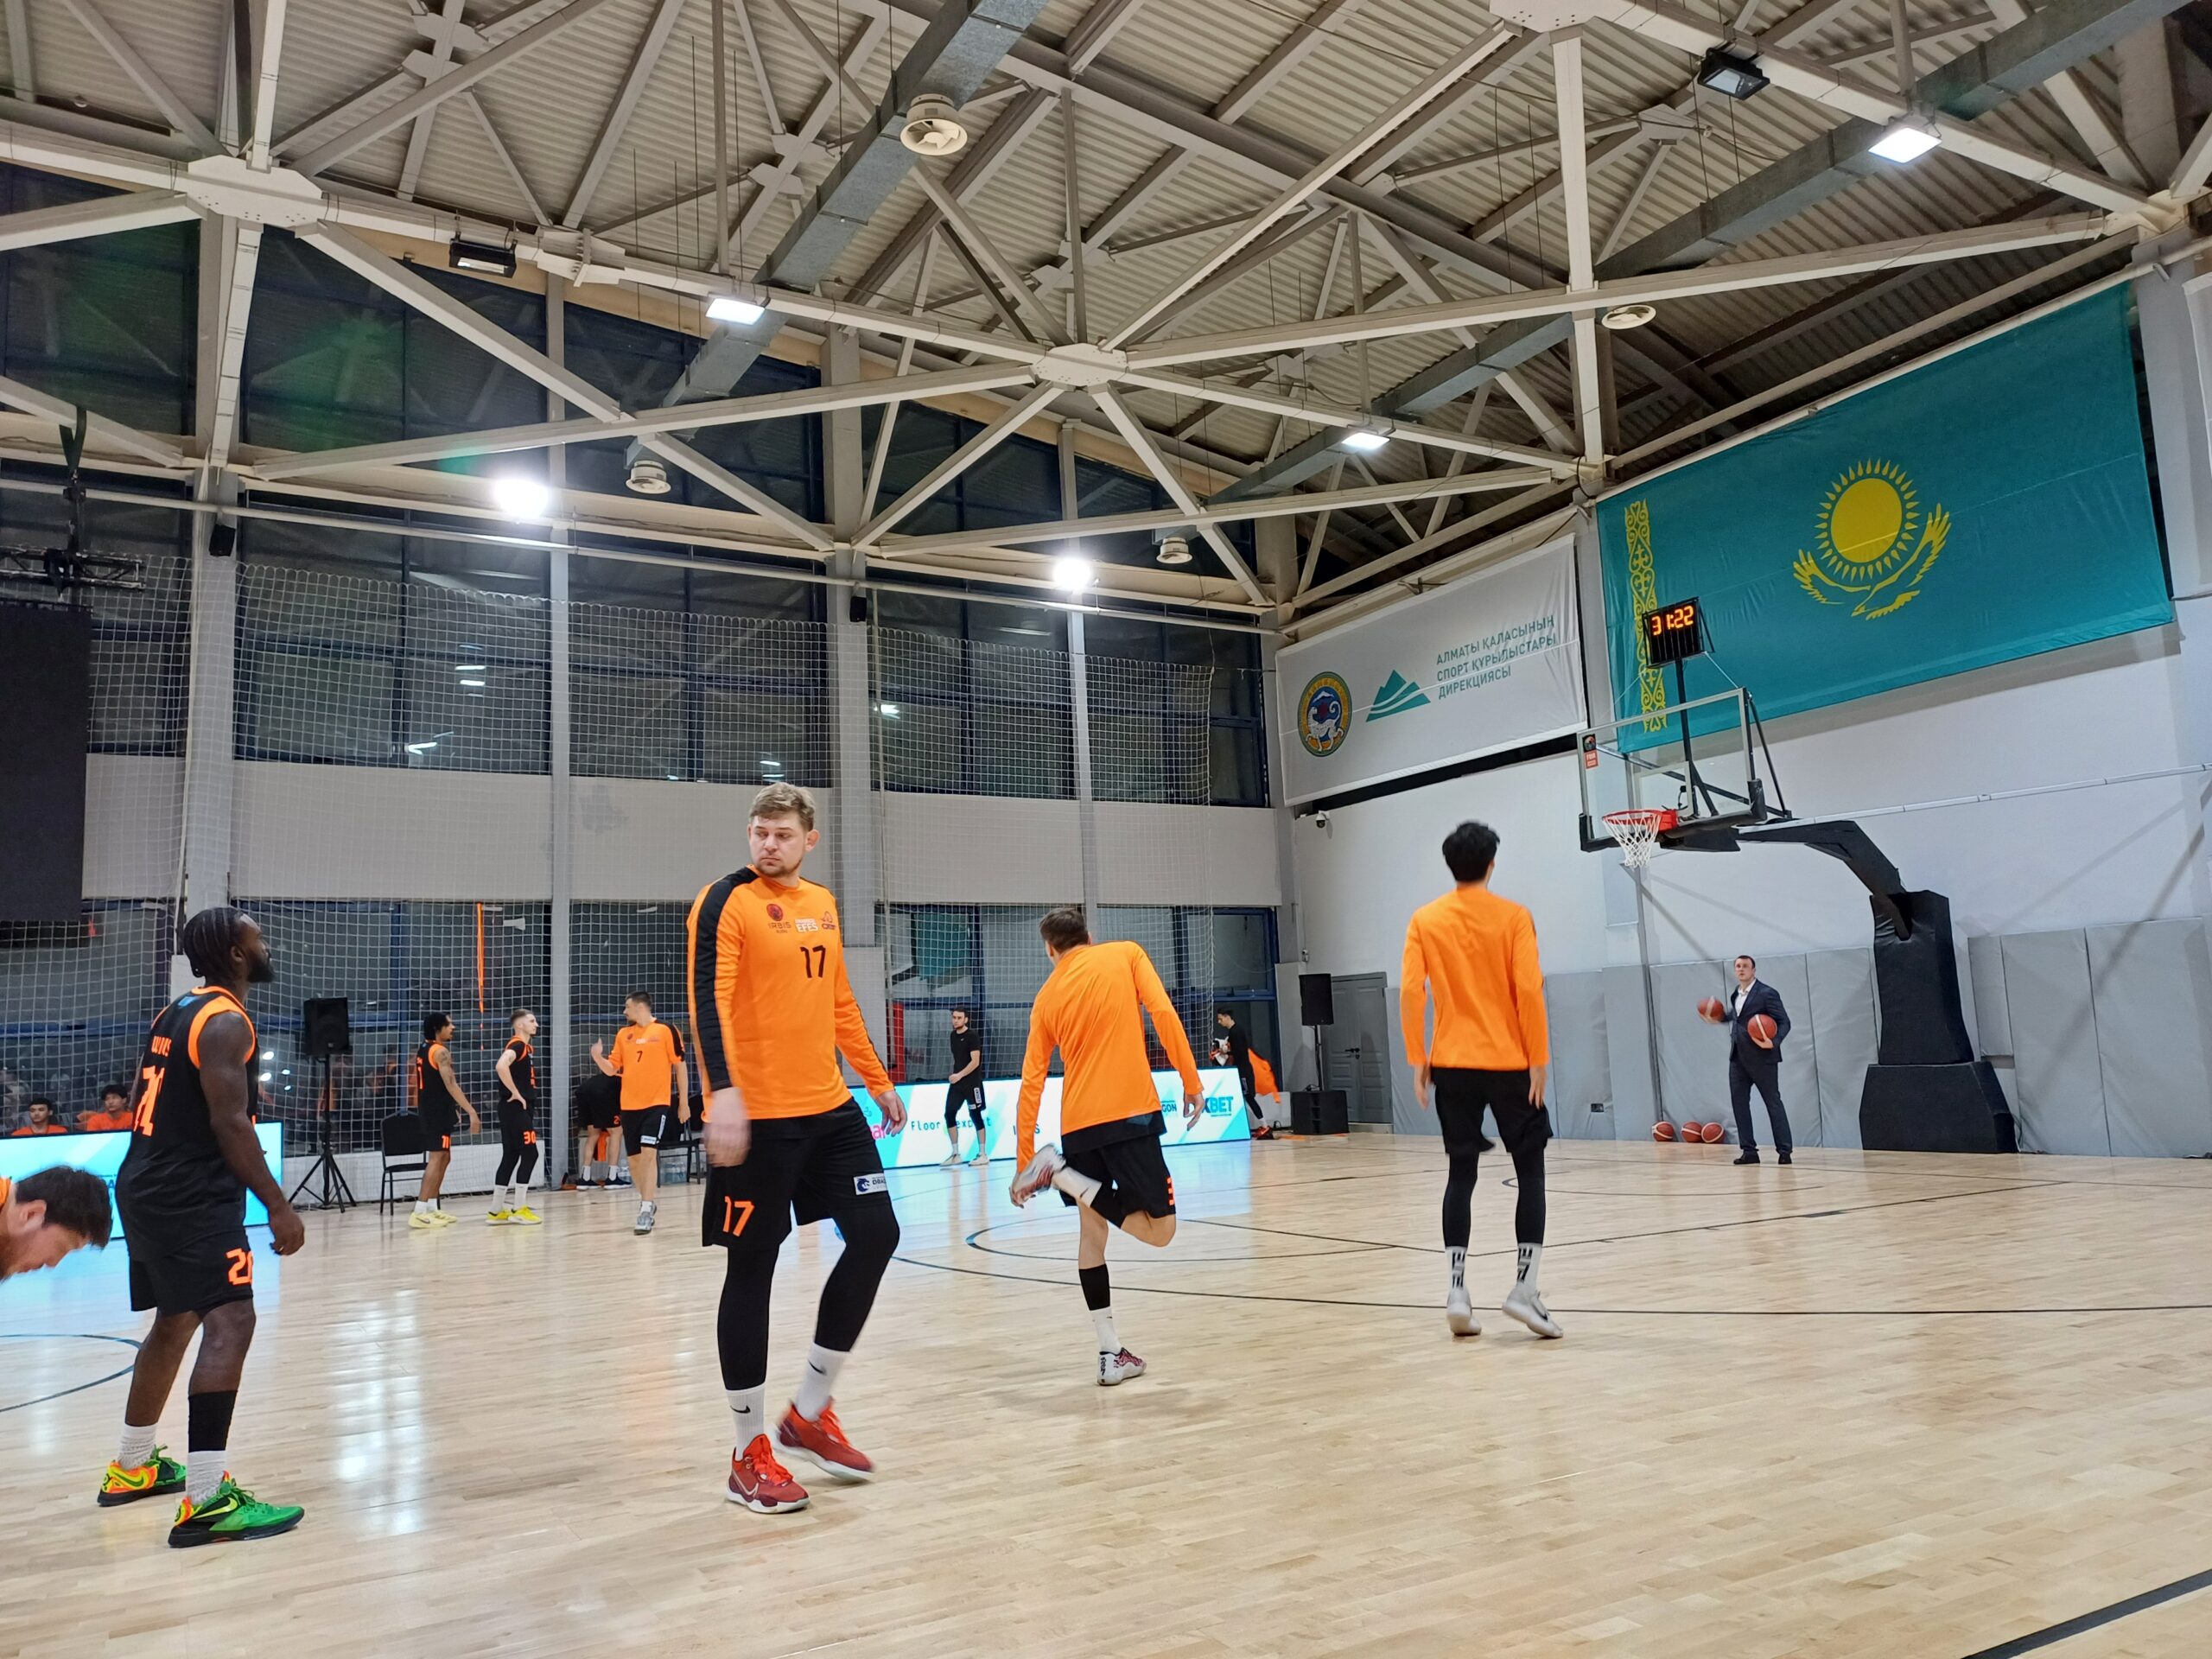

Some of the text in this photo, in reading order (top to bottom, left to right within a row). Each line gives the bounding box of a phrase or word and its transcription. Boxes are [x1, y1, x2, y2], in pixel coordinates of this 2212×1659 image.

[1436, 614, 1555, 665] АЛМАТЫ ҚАЛАСЫНЫҢ
[1436, 632, 1557, 683] СПОРТ ҚҰРЫЛЫСТАРЫ
[1438, 664, 1512, 700] ДИРЕКЦИЯСЫ
[795, 923, 819, 933] EFES
[799, 944, 827, 978] 17
[636, 1050, 644, 1063] 7
[523, 1130, 537, 1145] 30
[911, 1120, 941, 1131] Floor
[722, 1195, 755, 1237] 17
